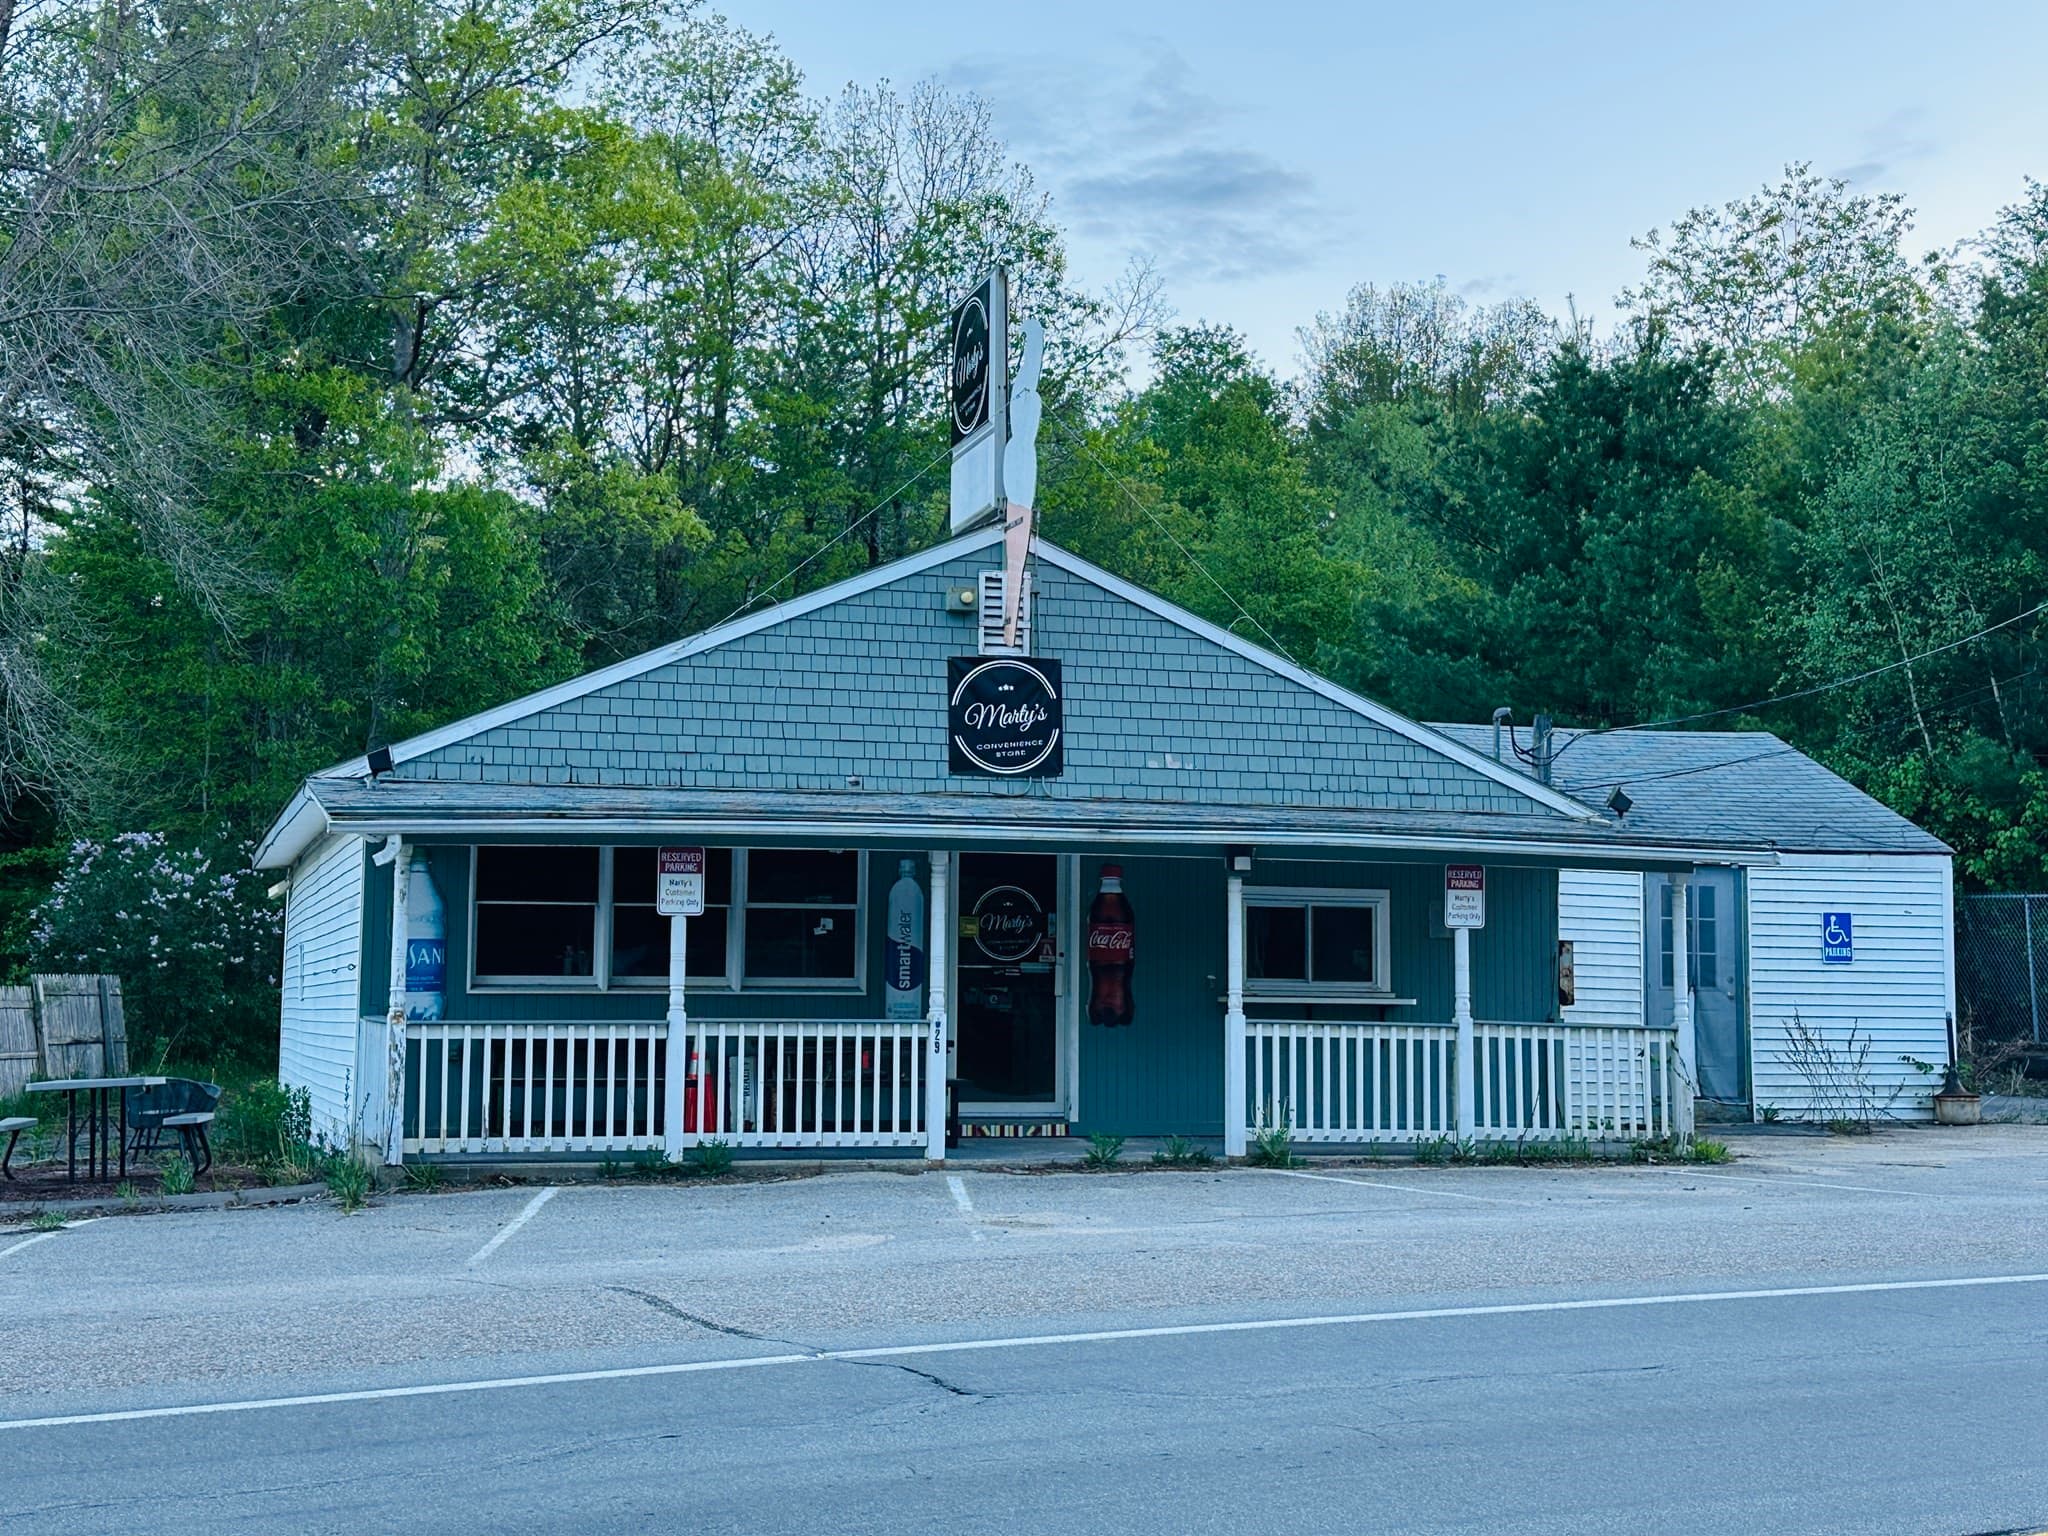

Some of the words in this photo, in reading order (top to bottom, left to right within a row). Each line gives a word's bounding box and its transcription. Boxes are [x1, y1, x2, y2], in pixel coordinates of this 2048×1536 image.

[964, 702, 1048, 732] Marty's
[976, 739, 1044, 750] CONVENIENCE
[996, 750, 1026, 758] STORE
[661, 852, 702, 862] RESERVED
[664, 862, 698, 872] PARKING
[1448, 870, 1482, 879] RESERVED
[669, 879, 693, 888] Marty's
[1450, 879, 1479, 889] PARKING
[665, 888, 696, 897] Customer
[661, 898, 685, 907] Parking
[686, 898, 699, 907] Only
[1454, 895, 1475, 904] Marty's
[979, 912, 1033, 934] Marty's
[899, 909, 912, 988] smartwater
[1825, 947, 1851, 957] PARKING
[408, 943, 446, 969] SANI
